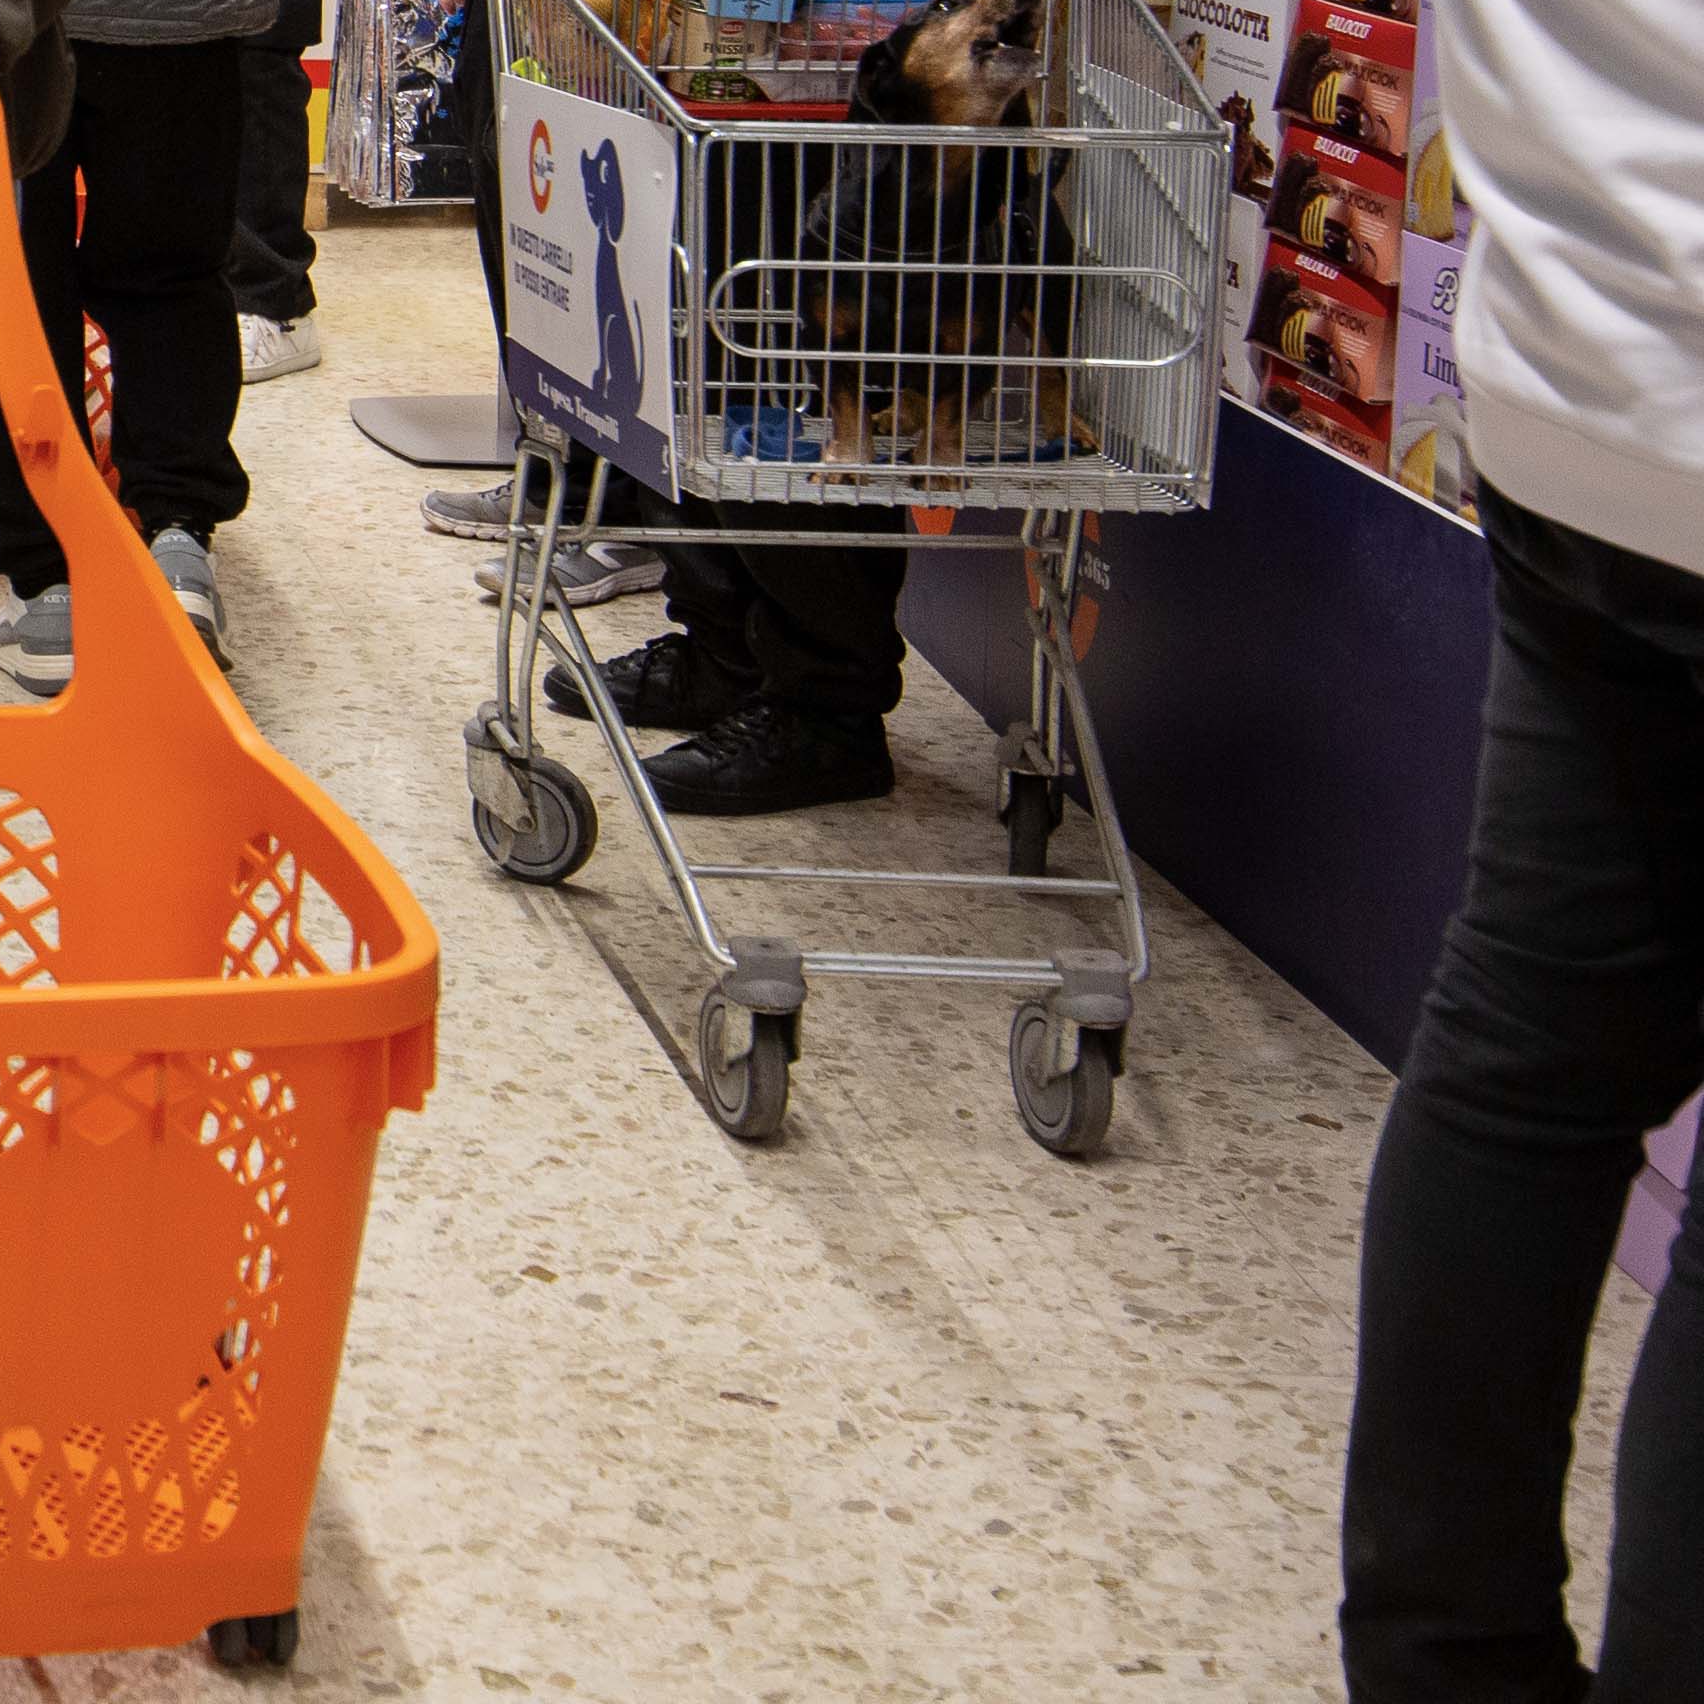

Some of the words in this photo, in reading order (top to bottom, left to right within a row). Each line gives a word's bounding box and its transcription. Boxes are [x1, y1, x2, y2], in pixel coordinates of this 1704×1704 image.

[1325, 13, 1372, 40] BALOCCO
[1313, 134, 1361, 165] BALOCCO
[517, 226, 540, 259] QUESTO
[541, 237, 573, 276] CARRELLO
[541, 275, 570, 313] ENTRARE
[537, 371, 550, 398] La
